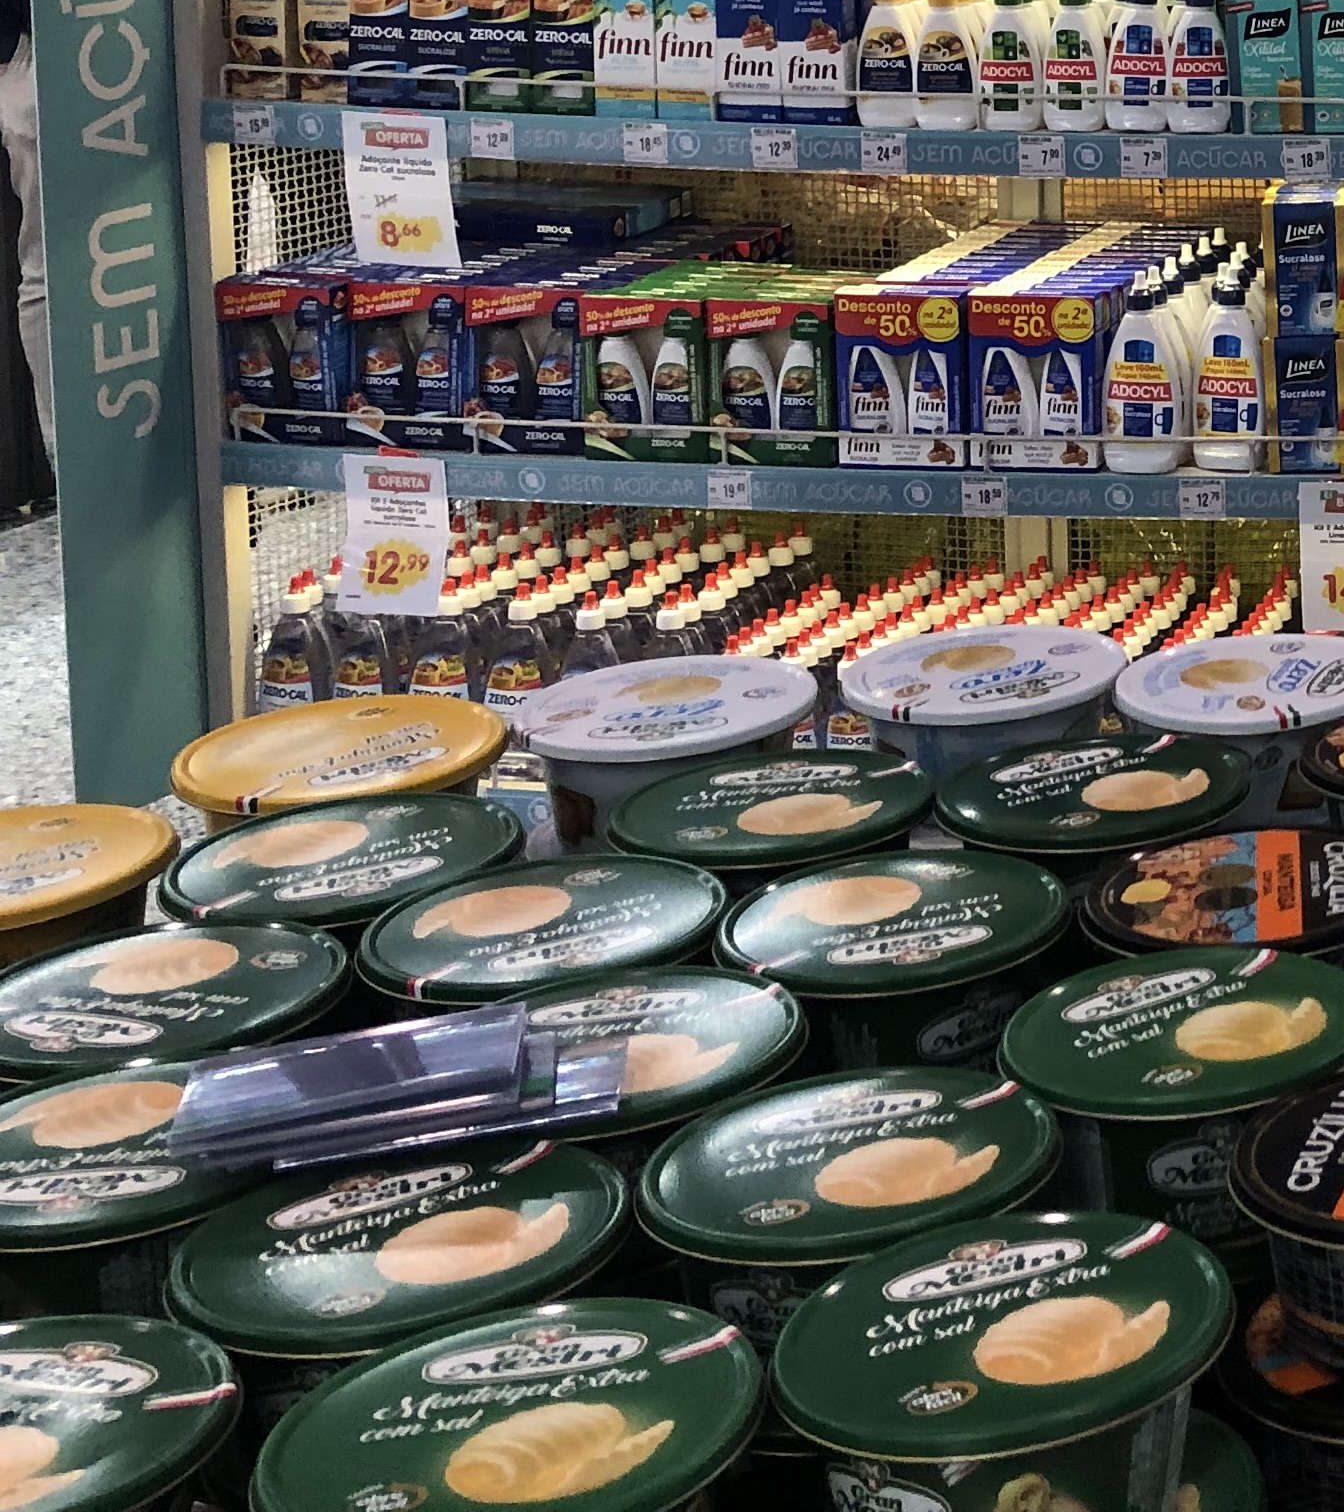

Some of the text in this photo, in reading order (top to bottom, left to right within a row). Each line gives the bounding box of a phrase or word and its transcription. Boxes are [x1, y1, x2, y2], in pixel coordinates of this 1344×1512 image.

[659, 32, 714, 62] finn
[982, 63, 1031, 79] ADOCYL
[1111, 57, 1165, 74] ADOCYL
[376, 129, 424, 147] OFERTA
[379, 220, 422, 248] 8,66
[88, 198, 162, 440] SEM
[838, 301, 912, 316] Desconto
[1112, 382, 1169, 399] ADOCYL
[365, 549, 429, 585] 12,99
[866, 1286, 1024, 1340] Manteiga
[868, 1316, 976, 1358] com sal
[373, 1384, 553, 1422] Manteiga
[359, 1410, 484, 1444] com sal
